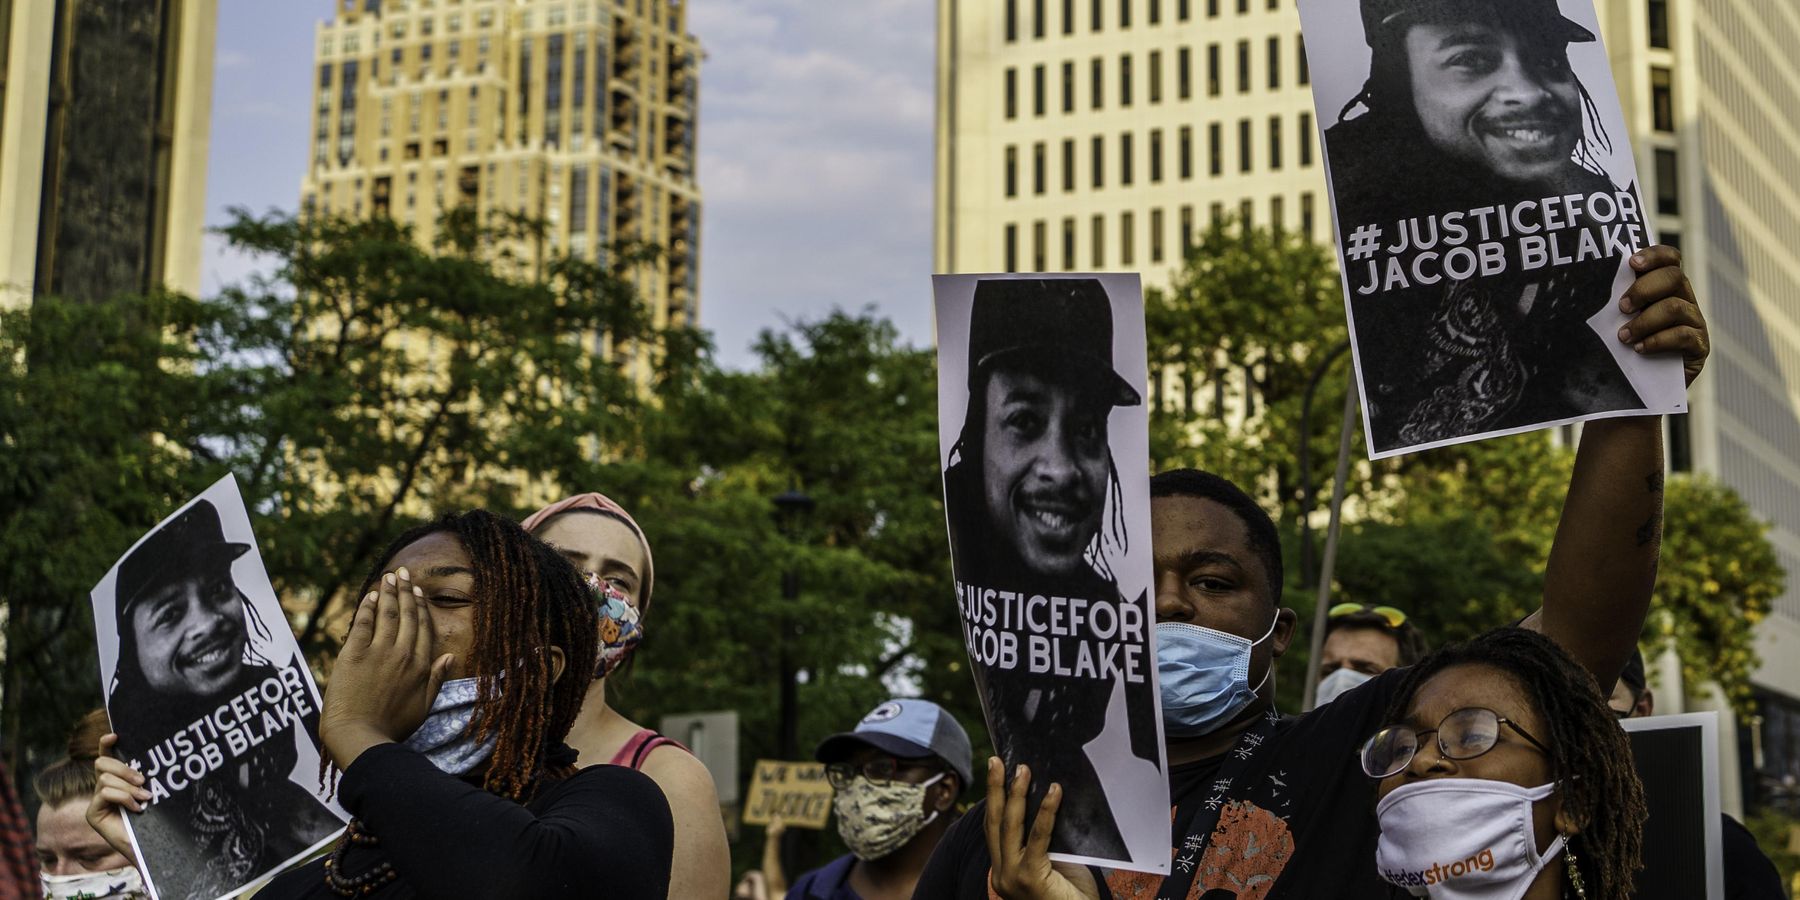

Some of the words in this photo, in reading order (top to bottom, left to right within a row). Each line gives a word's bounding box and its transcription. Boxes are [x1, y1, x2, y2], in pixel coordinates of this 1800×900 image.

[1347, 191, 1640, 260] #JUSTICEFOR
[1357, 242, 1506, 295] JACOB
[1519, 224, 1641, 271] BLAKE
[964, 621, 1018, 670] ACOB
[1029, 635, 1145, 683] BLAKE
[141, 742, 224, 810] ACOB
[224, 689, 312, 757] BLAKE
